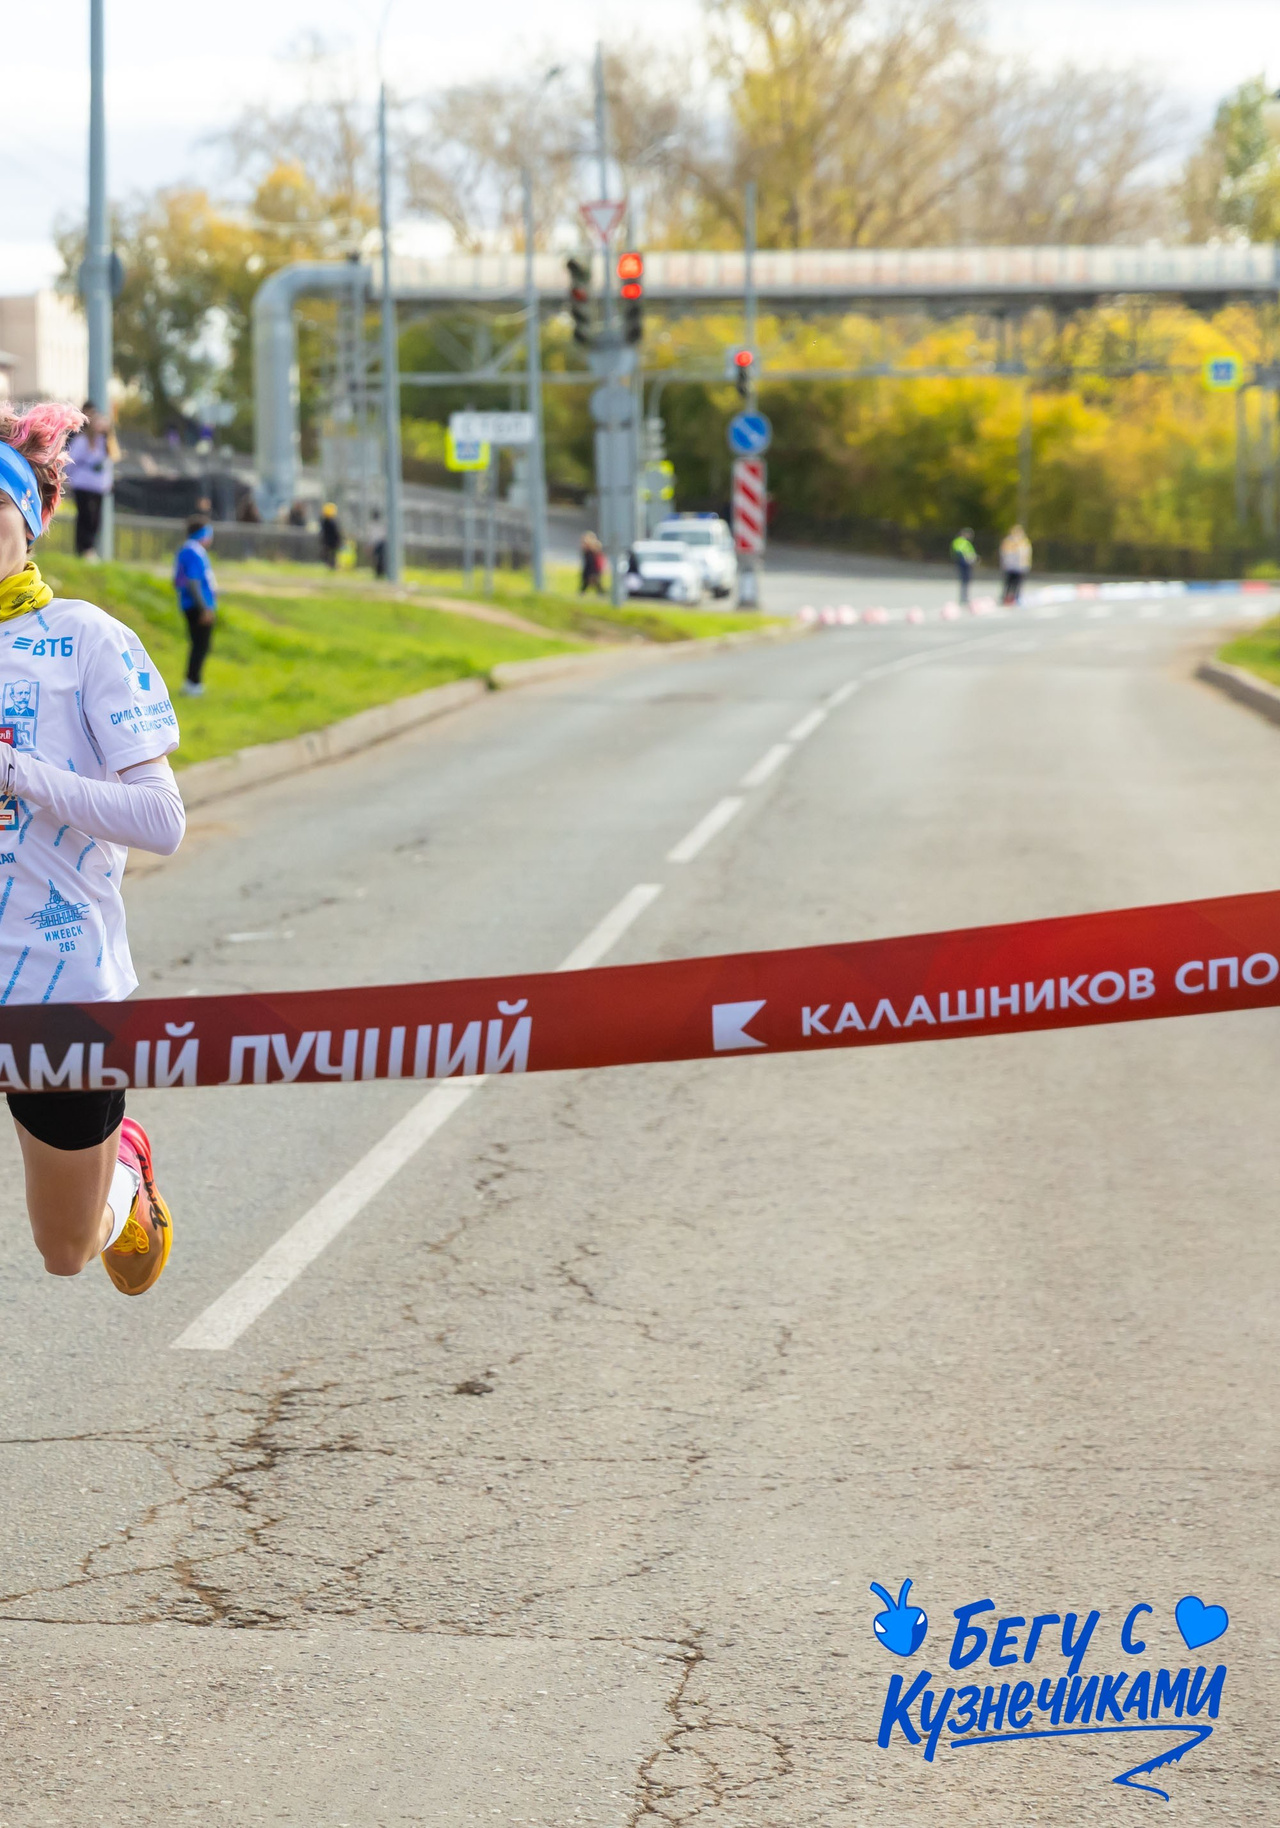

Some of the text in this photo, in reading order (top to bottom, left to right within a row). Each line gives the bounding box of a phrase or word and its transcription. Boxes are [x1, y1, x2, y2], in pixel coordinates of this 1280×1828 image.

[32, 636, 74, 658] ВТБ
[44, 926, 84, 942] ИЖЕВСК
[59, 941, 76, 953] 265
[801, 966, 1156, 1037] КАЛАШНИКОВ
[219, 998, 533, 1085] ЛУЧШИЙ
